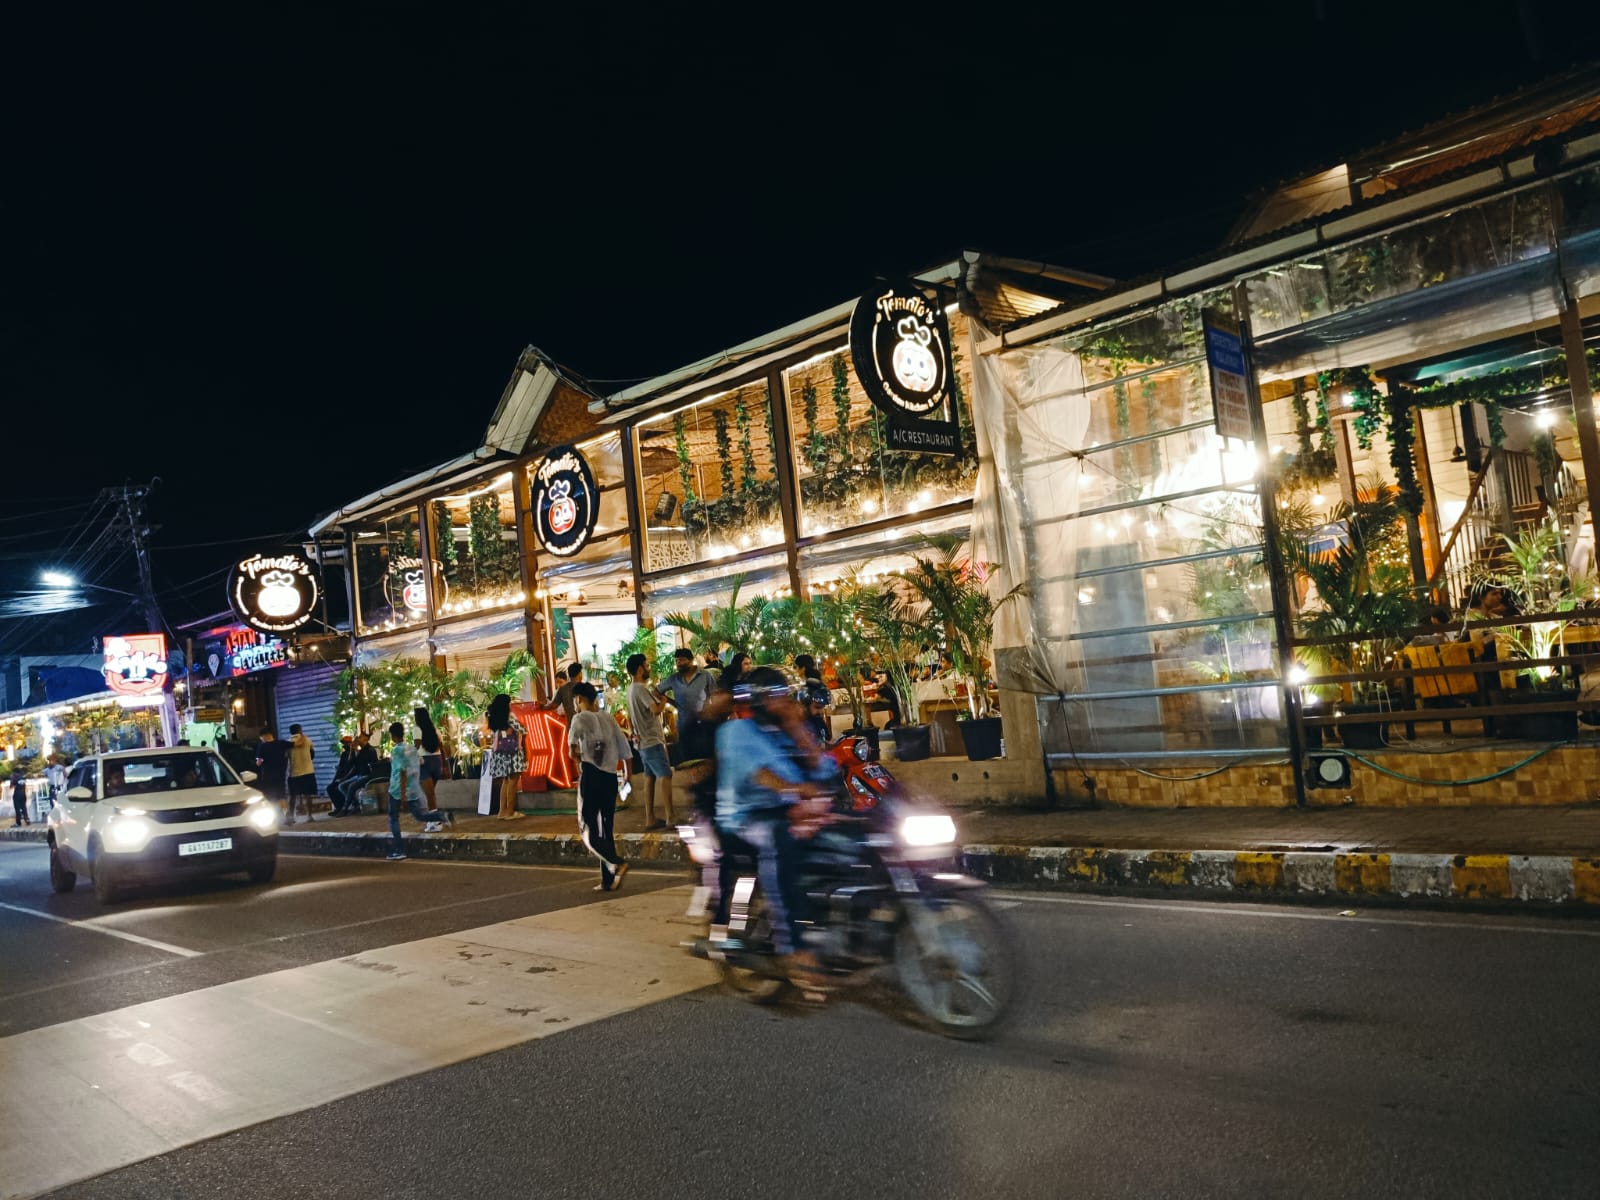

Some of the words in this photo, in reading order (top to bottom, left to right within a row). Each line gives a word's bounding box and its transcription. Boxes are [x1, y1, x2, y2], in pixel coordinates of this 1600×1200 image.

[877, 289, 935, 324] Tomato's
[908, 431, 954, 447] RESTAURANT
[239, 554, 310, 579] Tomato's
[225, 629, 256, 654] ASIAN
